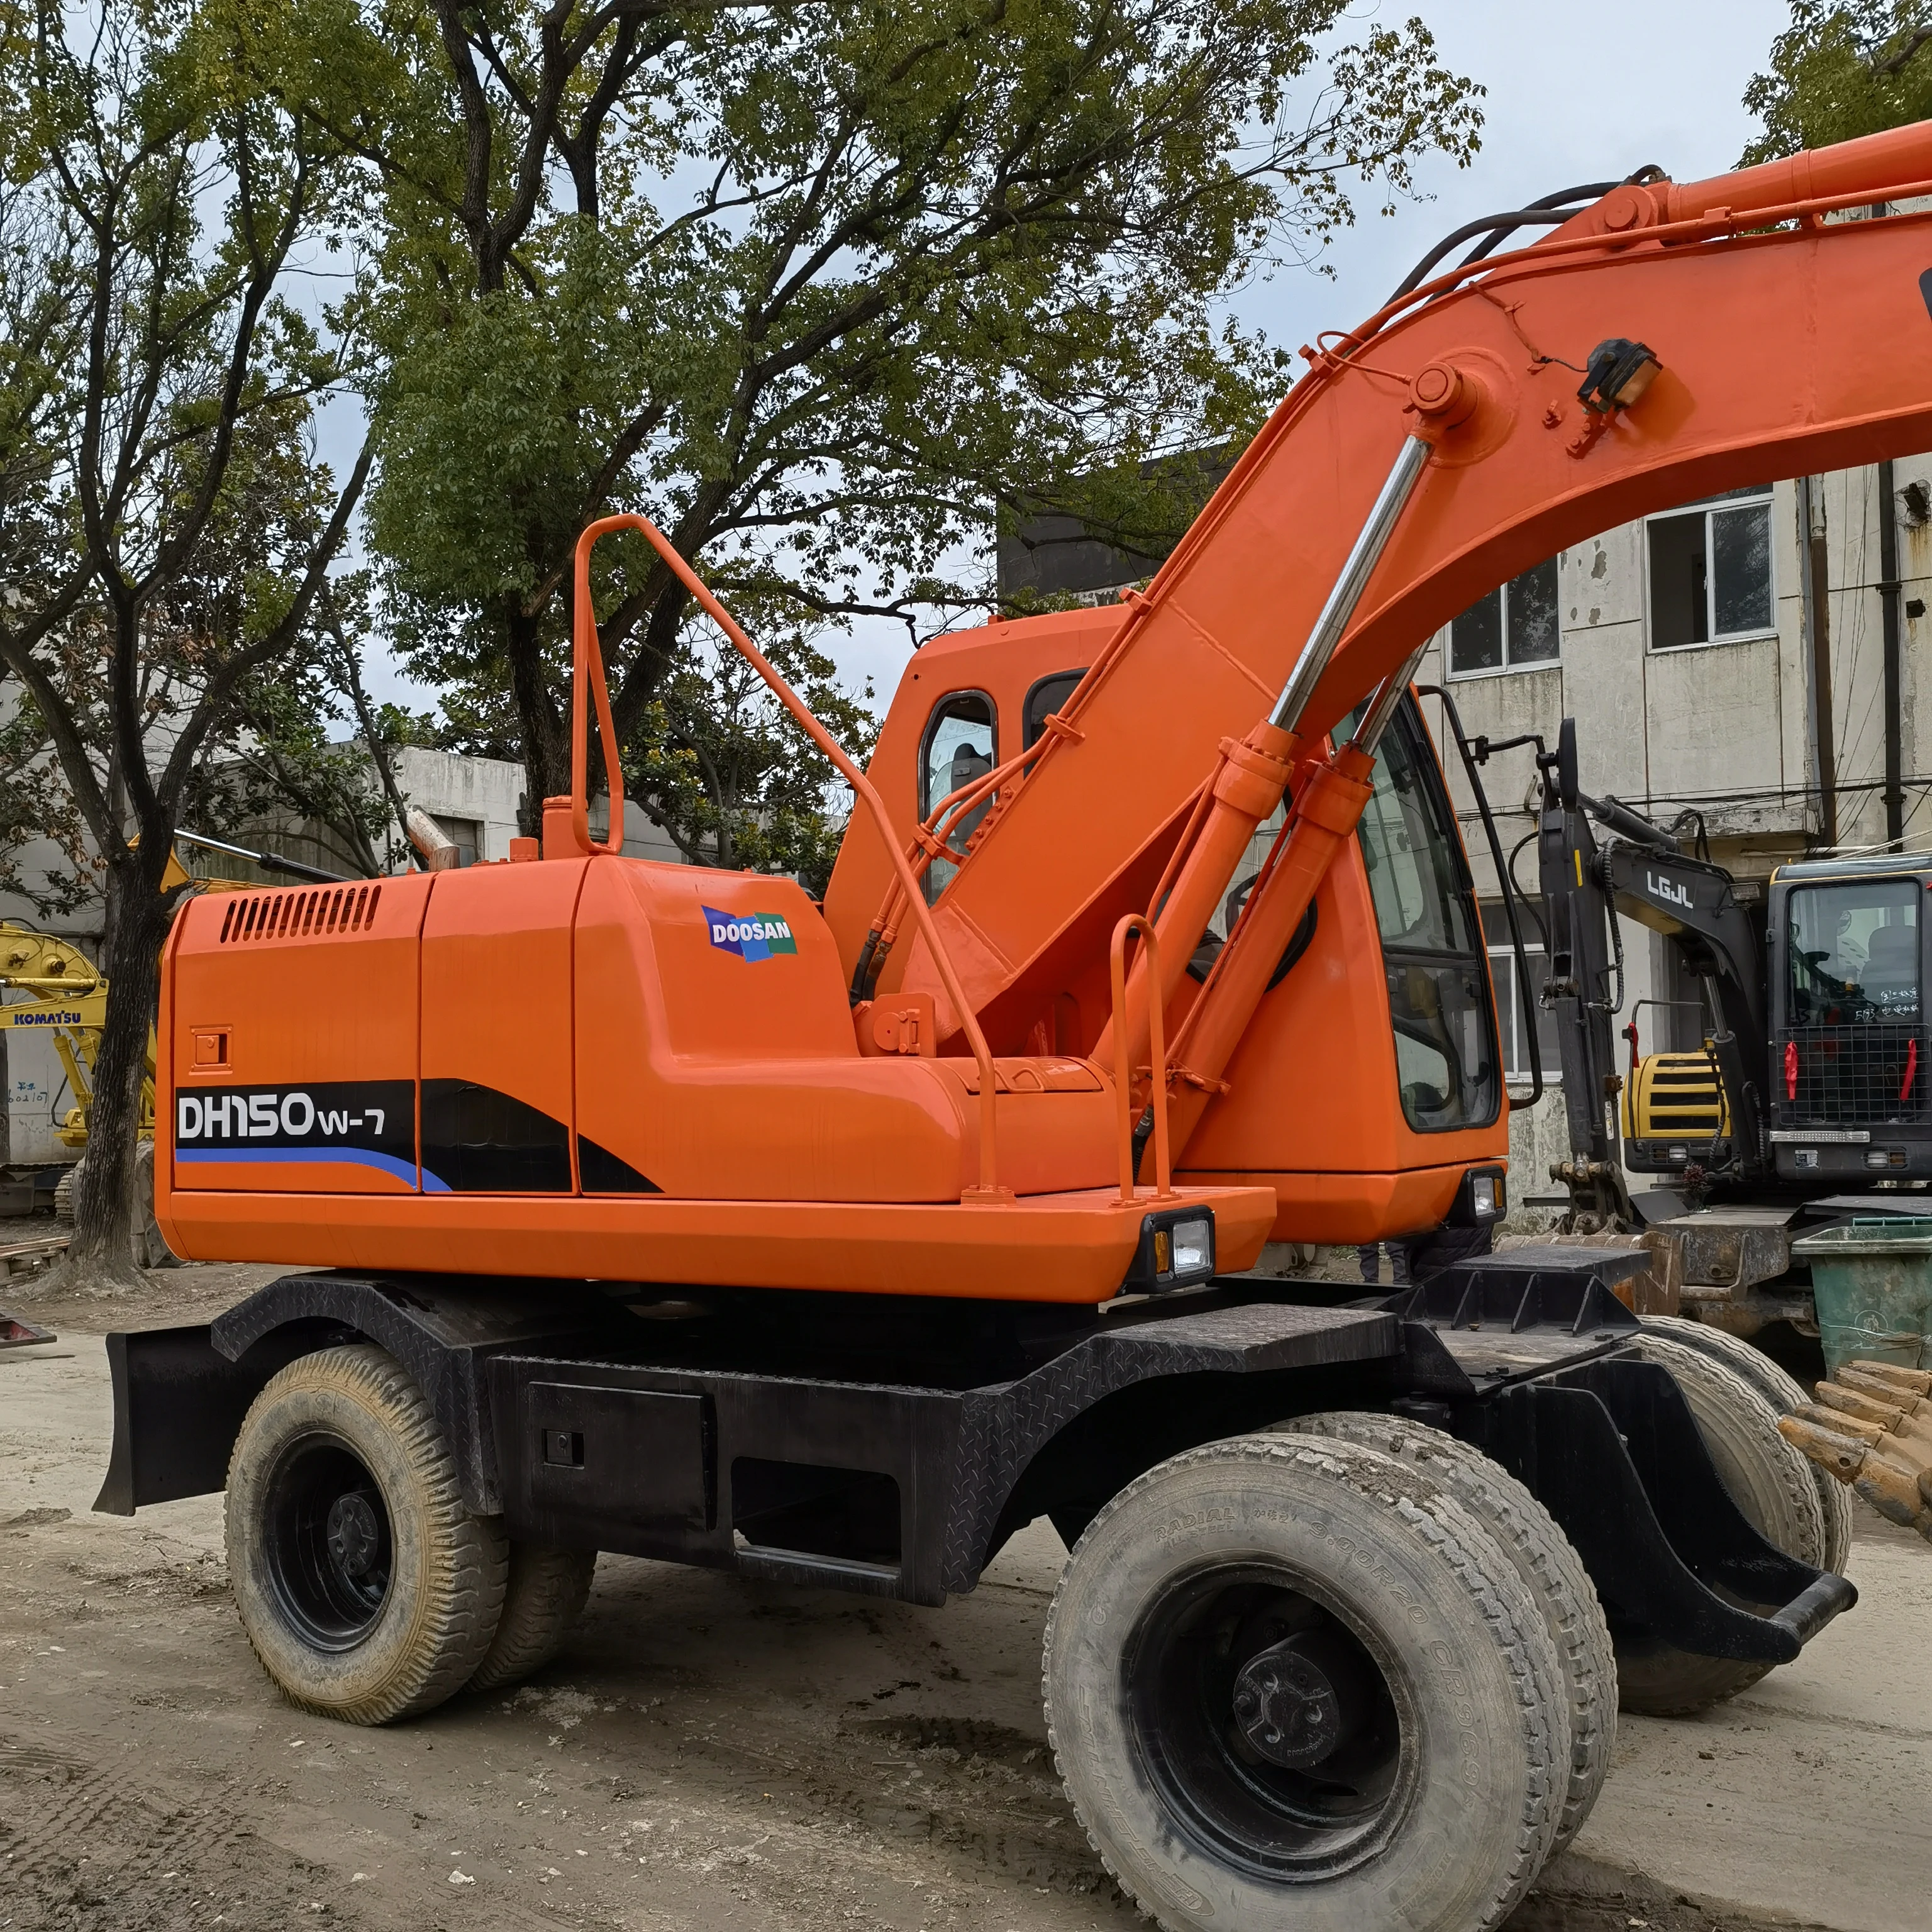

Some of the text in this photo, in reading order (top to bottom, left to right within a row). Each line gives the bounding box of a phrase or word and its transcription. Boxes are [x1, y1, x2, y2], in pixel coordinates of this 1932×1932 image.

[1647, 871, 1693, 909] LGJL
[713, 922, 791, 943] DOOSAN
[14, 1010, 81, 1025] KOMATSU
[1153, 1508, 1236, 1542] RADIAL
[1308, 1522, 1429, 1624] 9.00R20
